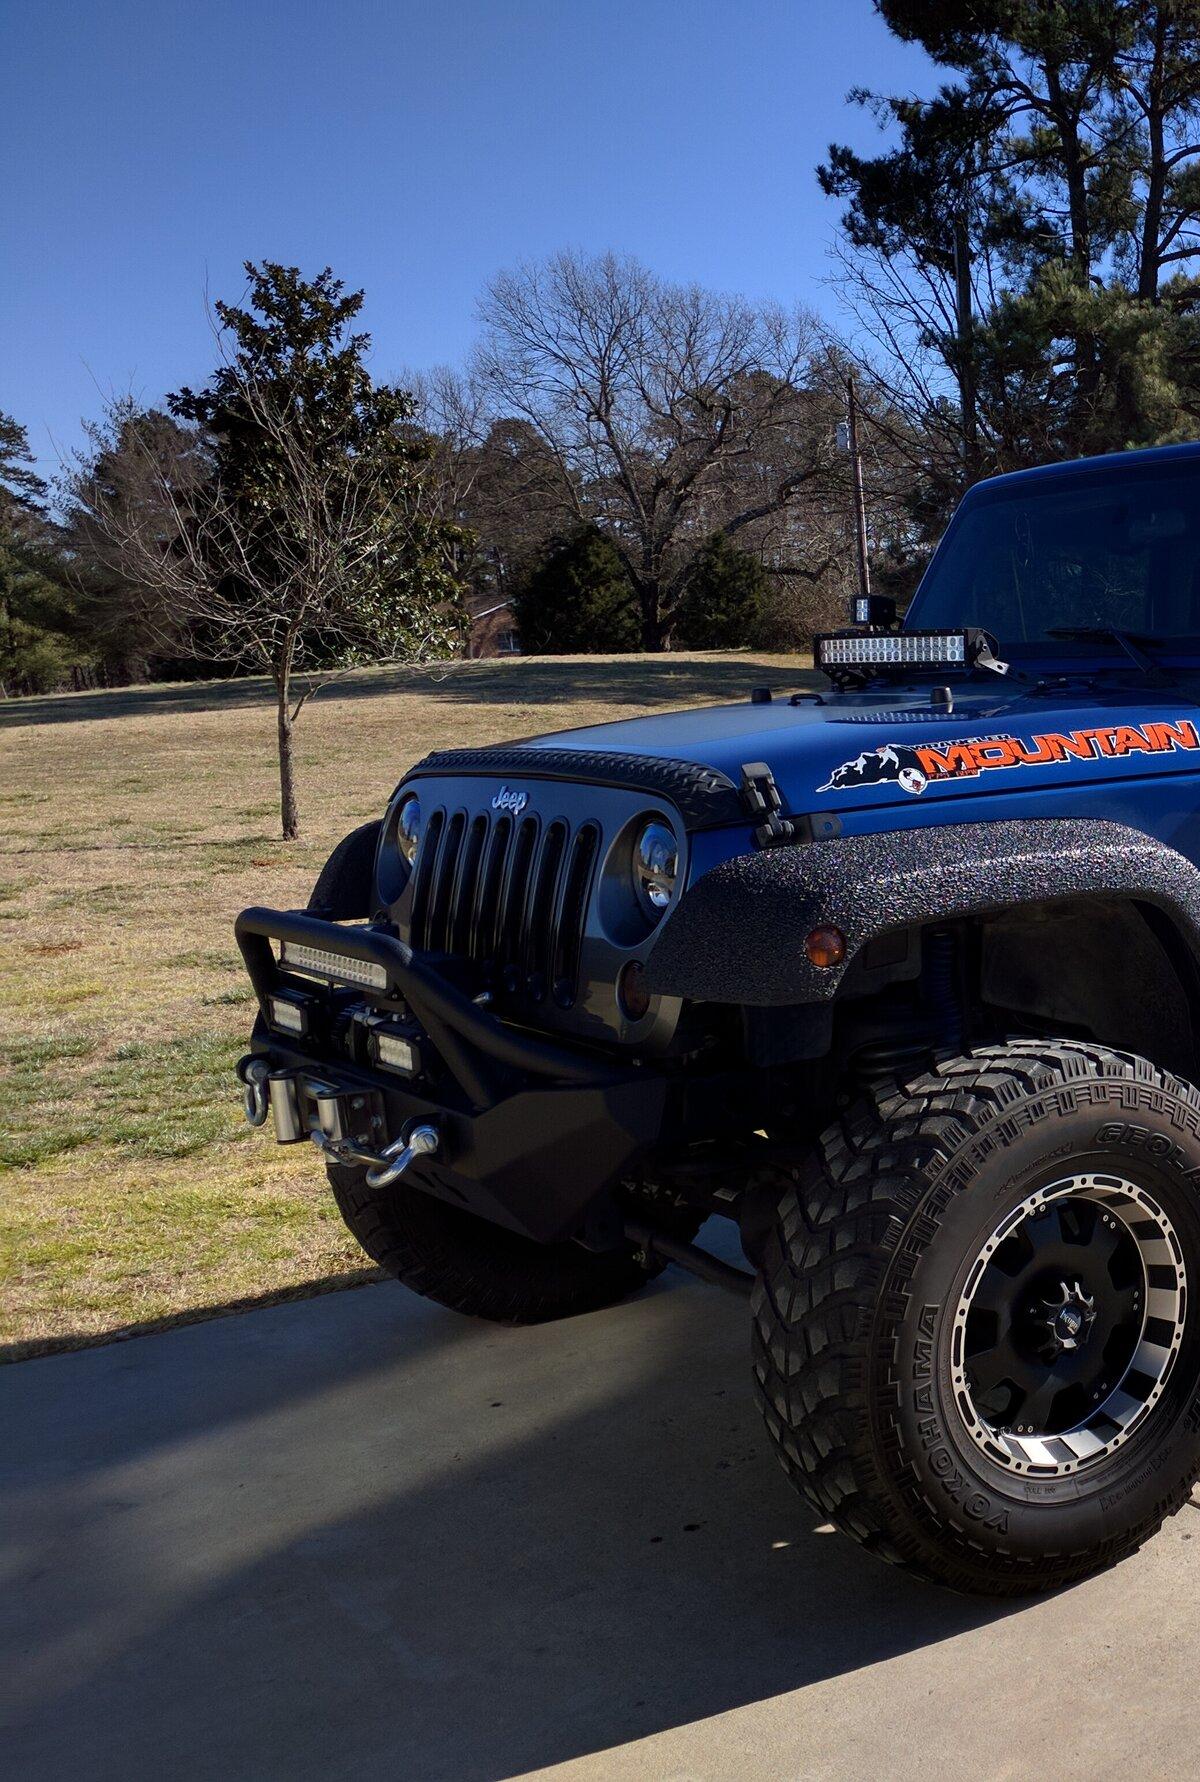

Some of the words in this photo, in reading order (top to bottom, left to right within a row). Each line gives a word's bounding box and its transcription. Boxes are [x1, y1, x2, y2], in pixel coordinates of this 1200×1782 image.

[915, 721, 1200, 773] MOUNTAIN
[492, 785, 526, 815] Jeep
[913, 1304, 1012, 1536] YOKOHAMA
